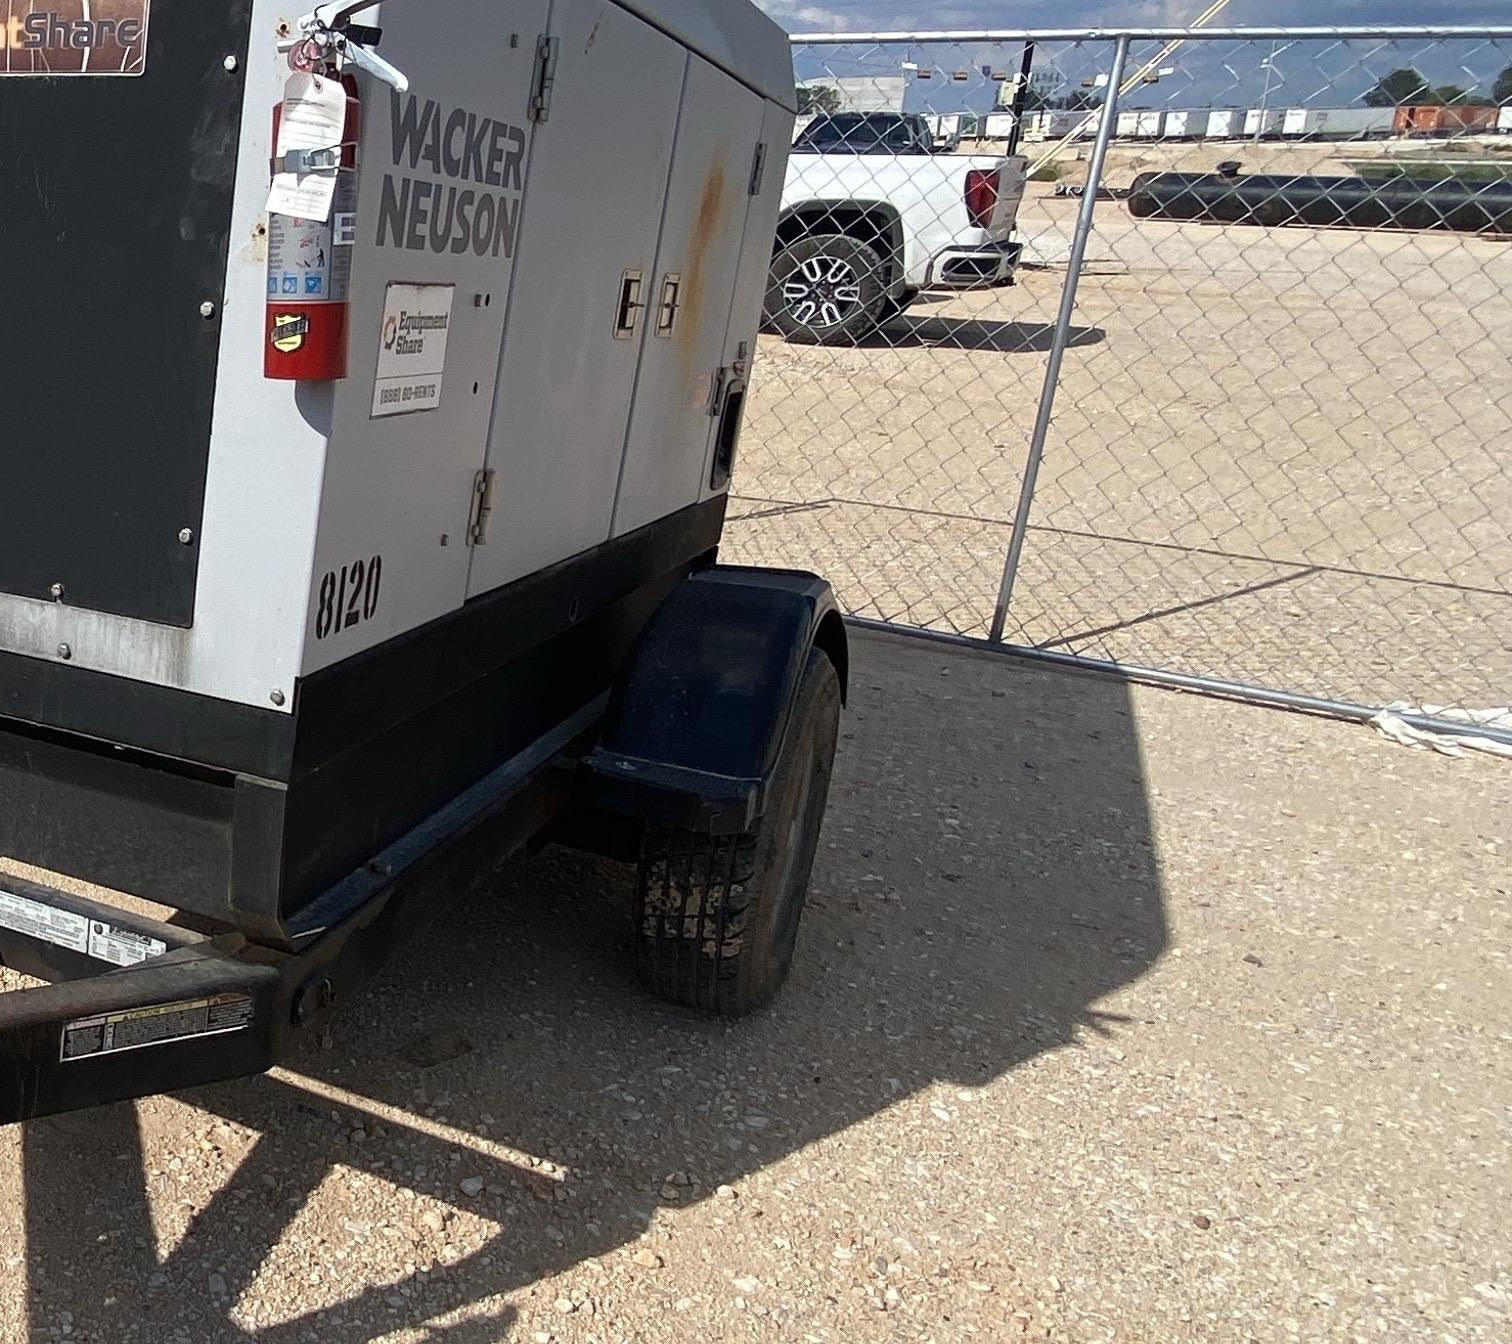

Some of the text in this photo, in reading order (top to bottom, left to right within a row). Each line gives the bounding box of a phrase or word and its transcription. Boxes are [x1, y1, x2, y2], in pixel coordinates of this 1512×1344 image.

[389, 86, 526, 191] WACKER
[375, 173, 520, 259] NEUSON
[396, 336, 423, 354] Share
[399, 311, 448, 334] Equipment
[315, 554, 382, 640] 8120
